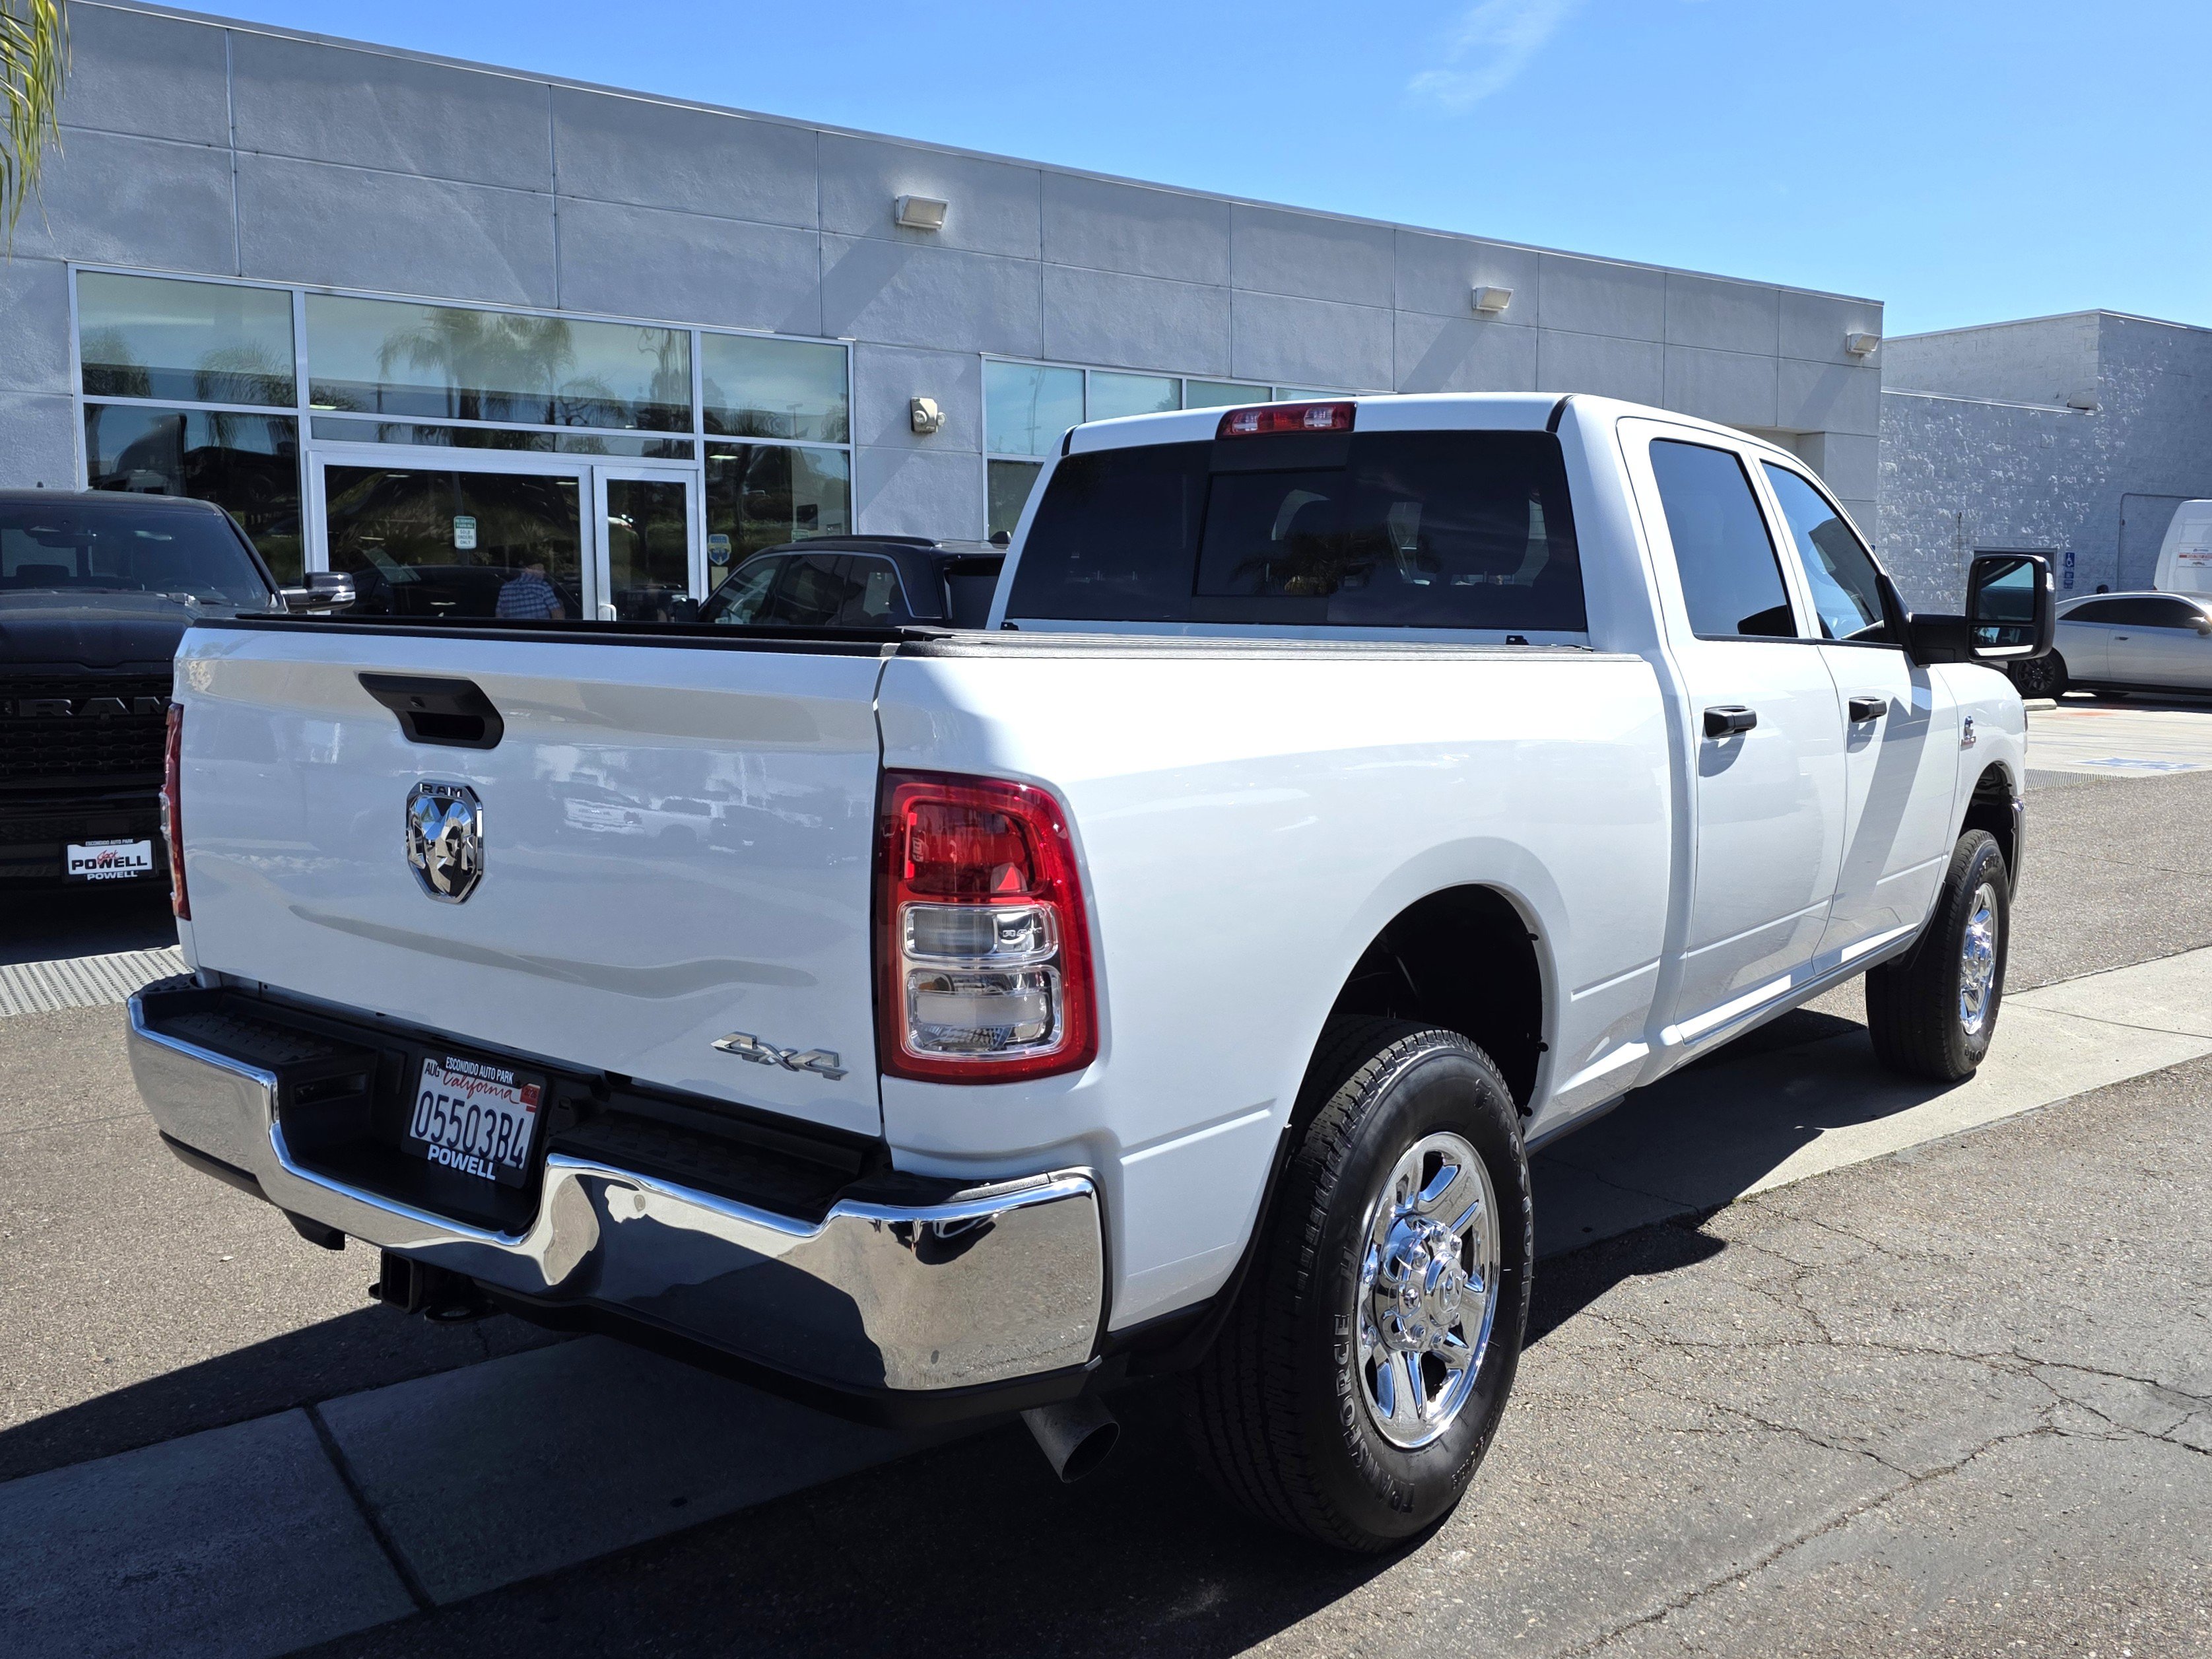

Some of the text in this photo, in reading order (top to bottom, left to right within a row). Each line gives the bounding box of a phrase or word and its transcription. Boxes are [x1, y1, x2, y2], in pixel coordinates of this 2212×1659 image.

[419, 783, 463, 797] RAM
[71, 856, 148, 870] POWELL
[86, 871, 138, 881] POWELL
[424, 1062, 440, 1077] AUG
[446, 1056, 514, 1085] ESCONDIDO AUTO PARK
[443, 1070, 520, 1105] California
[415, 1090, 525, 1169] 05503B4
[427, 1144, 496, 1181] POWELL
[1333, 1314, 1415, 1514] TRANSFORCE
